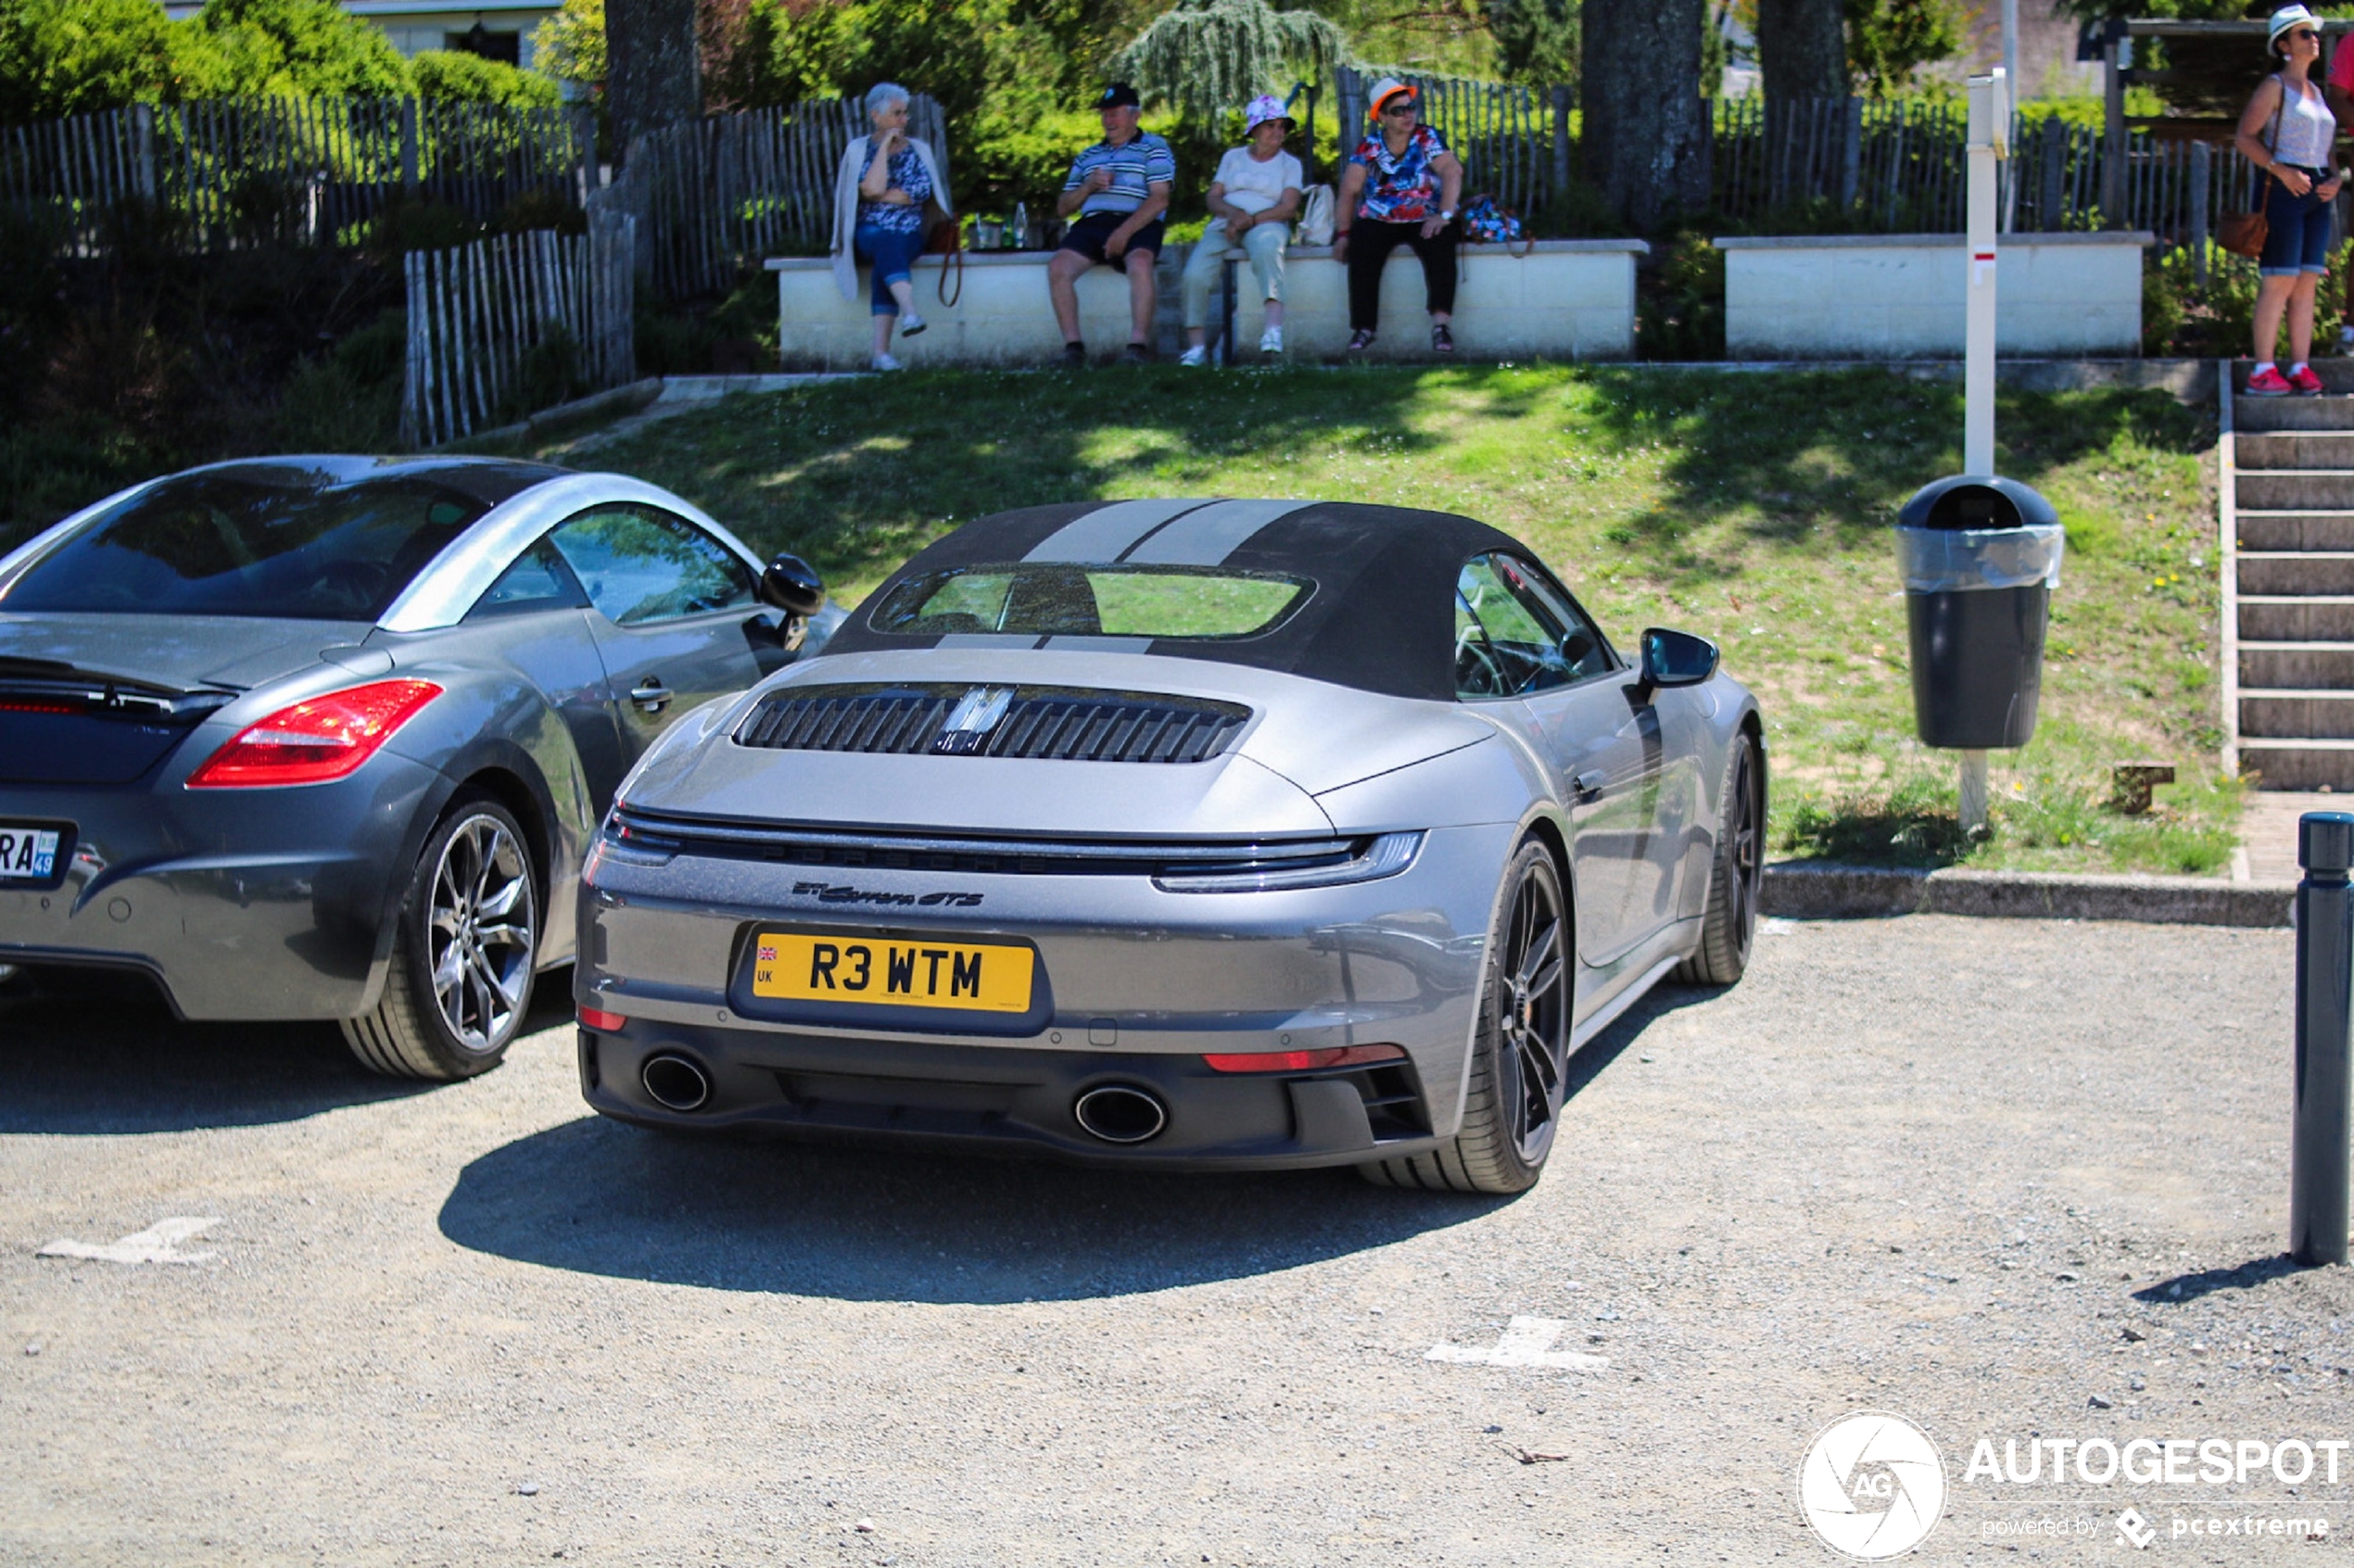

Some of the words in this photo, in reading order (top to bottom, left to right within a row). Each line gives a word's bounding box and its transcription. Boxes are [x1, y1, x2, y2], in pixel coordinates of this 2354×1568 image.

[34, 854, 53, 873] 49
[763, 844, 1047, 873] PORSCHE
[818, 886, 916, 905] Carrera
[918, 892, 984, 906] GTS
[757, 970, 773, 982] UK
[810, 943, 872, 991] R3
[887, 947, 982, 998] WTM
